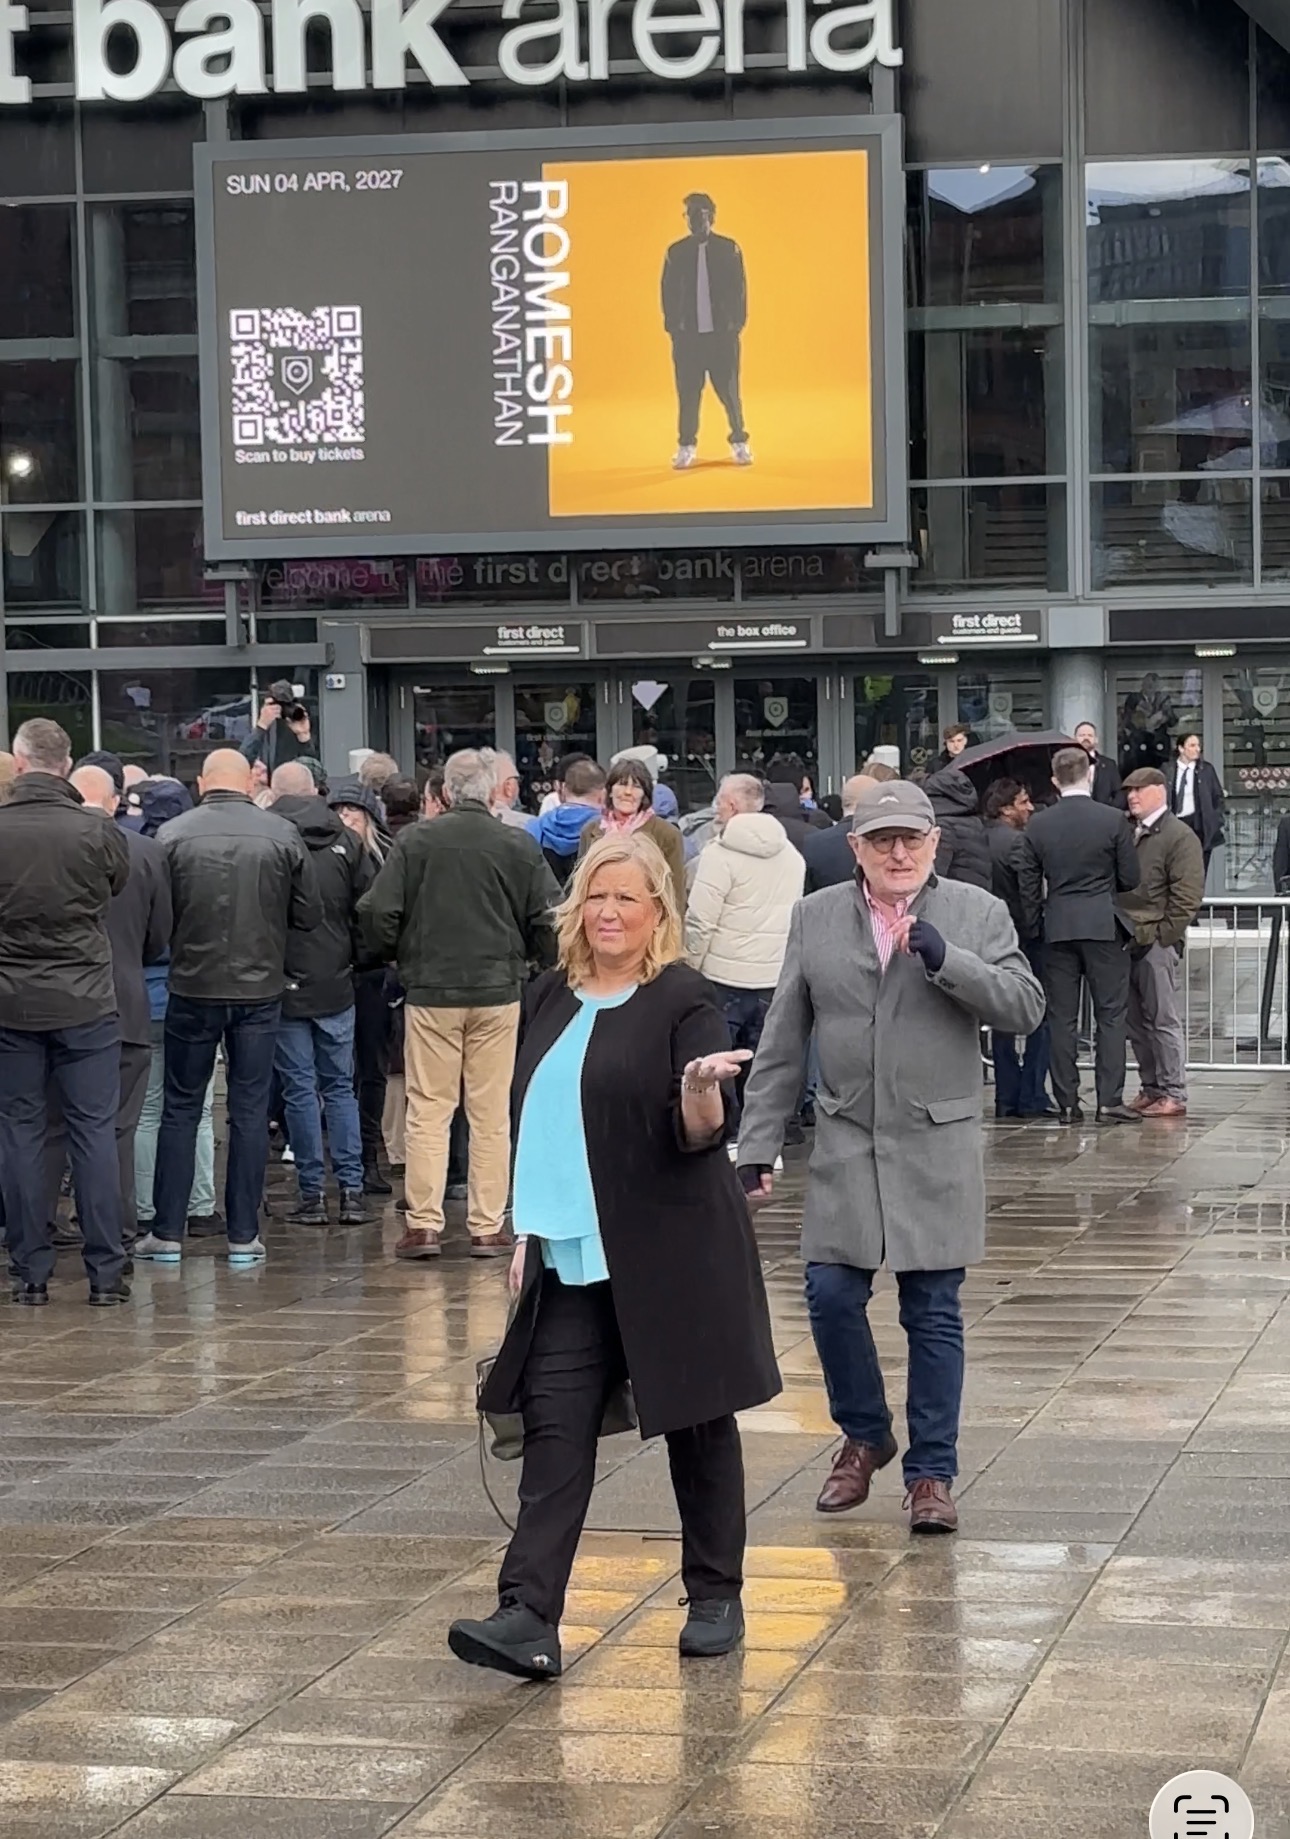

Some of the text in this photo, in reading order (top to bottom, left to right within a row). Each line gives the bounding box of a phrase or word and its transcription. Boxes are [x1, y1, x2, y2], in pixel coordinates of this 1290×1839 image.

[75, 0, 471, 100] bank
[499, 0, 904, 85] arena
[227, 169, 403, 194] SUN 04 APR, 2027
[489, 180, 524, 446] RANGANATHAN
[522, 178, 574, 446] ROMESH
[235, 447, 365, 464] Scan to buy tickets
[236, 508, 391, 525] first direct bank arena
[259, 561, 369, 591] elcome
[473, 556, 539, 584] first
[547, 555, 642, 583] drect
[745, 554, 824, 578] arena
[717, 623, 797, 637] the box office
[952, 613, 1022, 628] first direct
[497, 625, 565, 639] first direct
